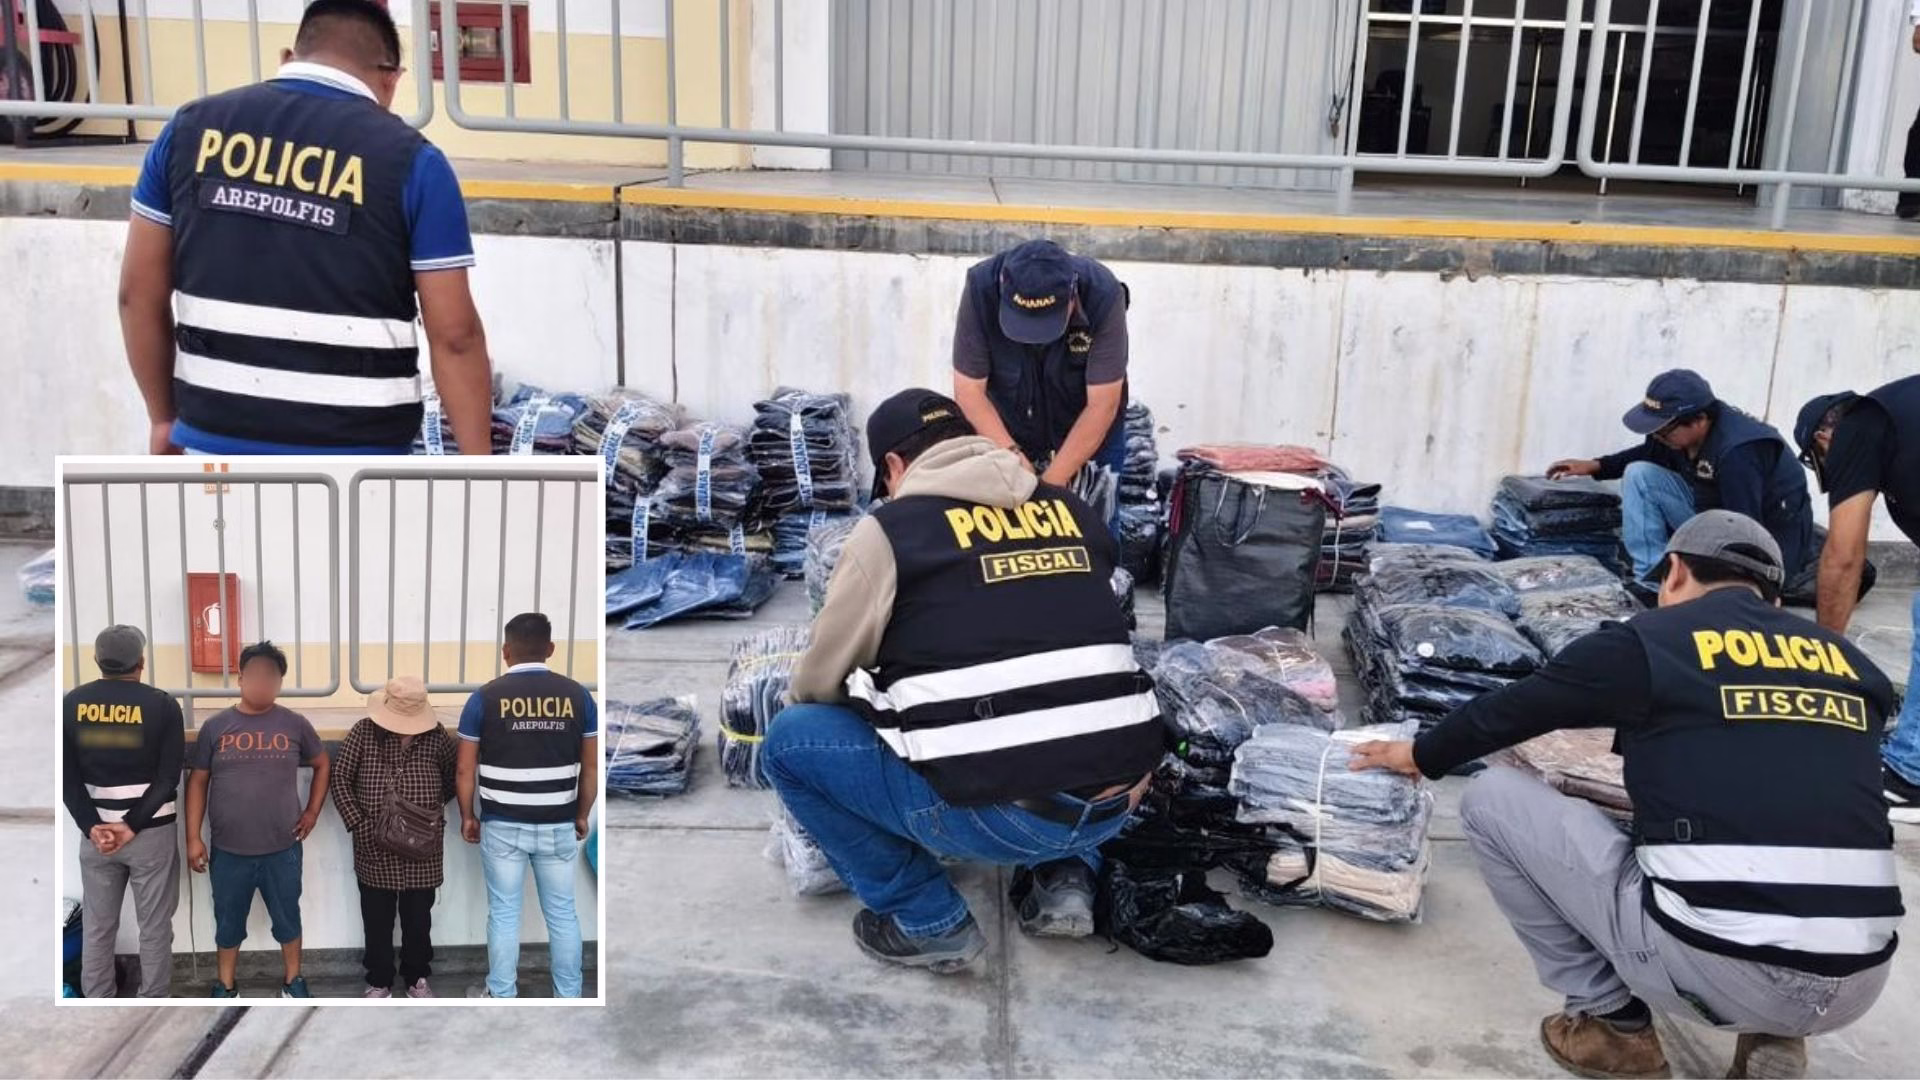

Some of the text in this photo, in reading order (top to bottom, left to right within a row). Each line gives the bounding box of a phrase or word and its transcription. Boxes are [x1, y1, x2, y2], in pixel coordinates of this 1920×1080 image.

[195, 128, 363, 205] POLICIA
[212, 186, 336, 227] AREPOLFIS
[992, 551, 1084, 577] FISCAL
[1692, 630, 1860, 681] POLICIA
[77, 703, 143, 724] POLICIA
[500, 696, 574, 718] POLICIA
[1734, 691, 1858, 724] FISCAL
[511, 720, 565, 730] AREPOLFIS
[219, 732, 289, 753] POLO
